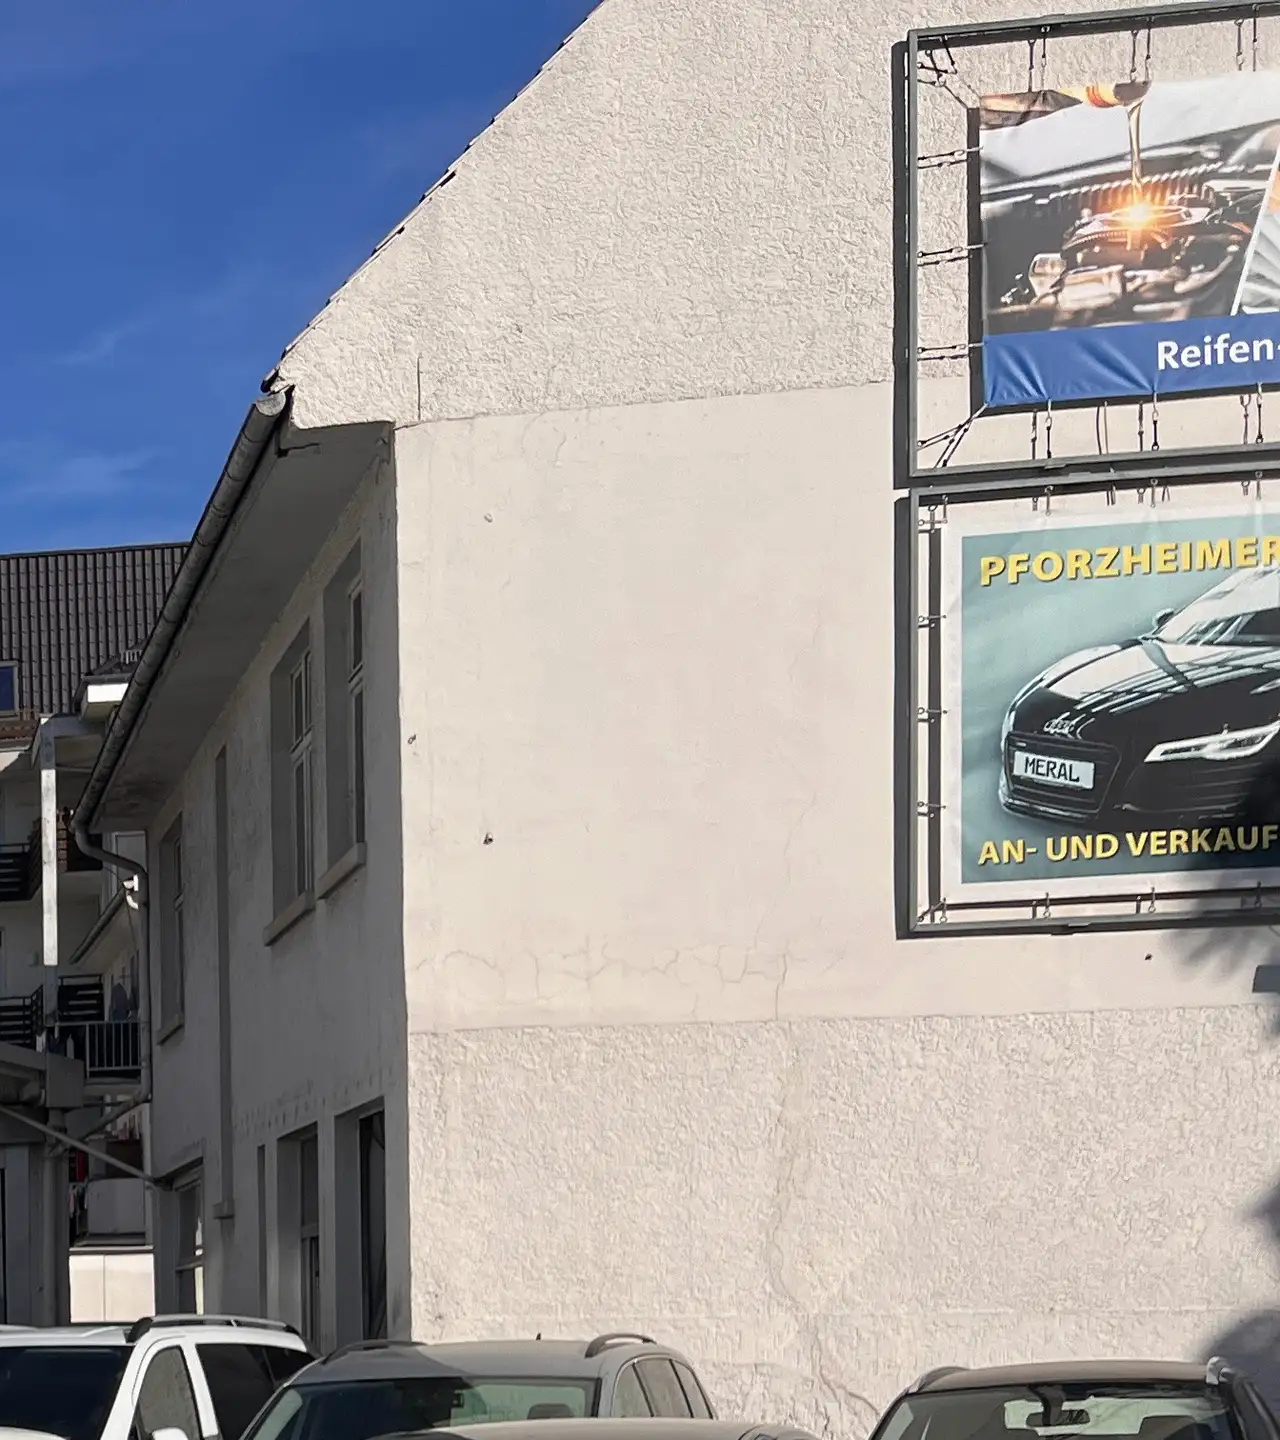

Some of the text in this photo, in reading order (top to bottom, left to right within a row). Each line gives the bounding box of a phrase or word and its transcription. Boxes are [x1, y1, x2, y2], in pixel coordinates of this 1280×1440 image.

[1157, 332, 1280, 371] Reifen
[980, 535, 1280, 586] PFORZHEIMER
[1025, 756, 1080, 782] MERAL
[978, 824, 1280, 865] AN- UND VERKAUF
